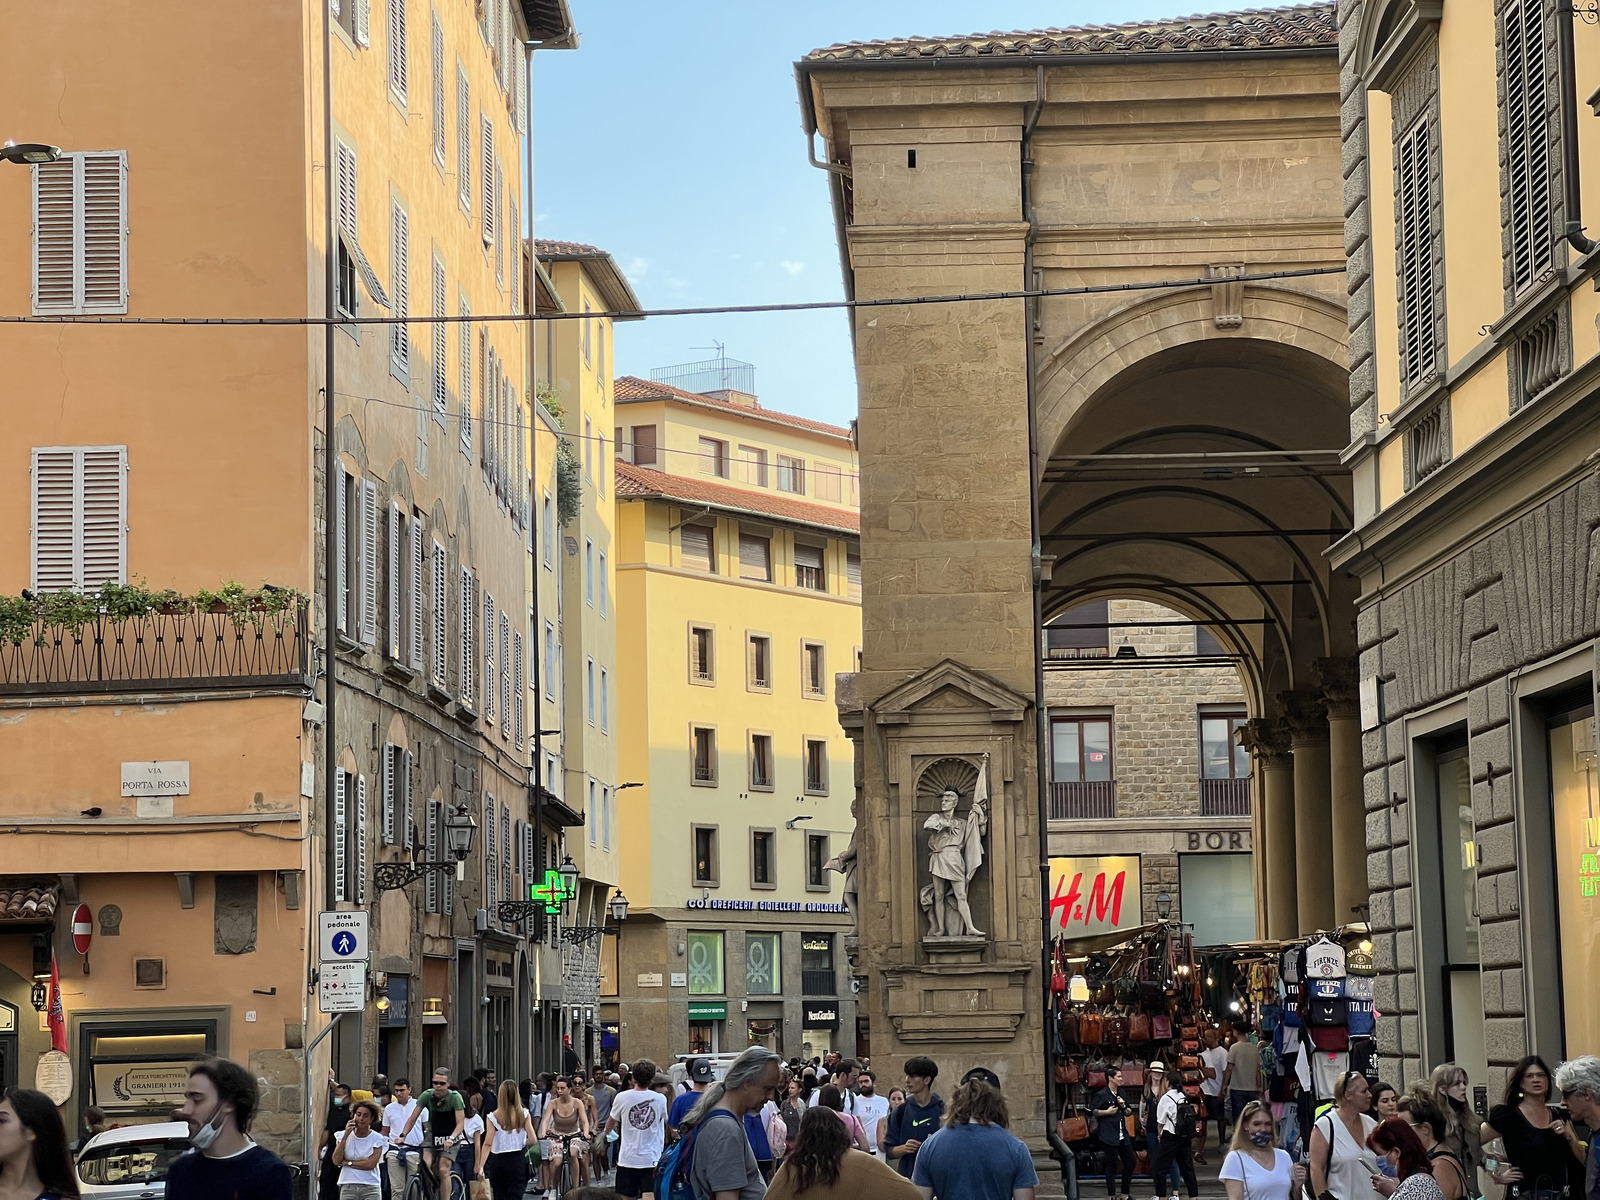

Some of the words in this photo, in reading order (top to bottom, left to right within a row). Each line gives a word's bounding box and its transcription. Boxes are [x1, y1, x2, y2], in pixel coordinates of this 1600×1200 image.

[122, 781, 153, 789] PORTA
[157, 780, 187, 789] ROSSA
[1187, 832, 1252, 850] BOR
[712, 900, 754, 910] OREFICERIA
[759, 901, 802, 911] GIOIELLERIA
[1050, 871, 1125, 929] H&M
[1313, 956, 1340, 969] FIRENZE
